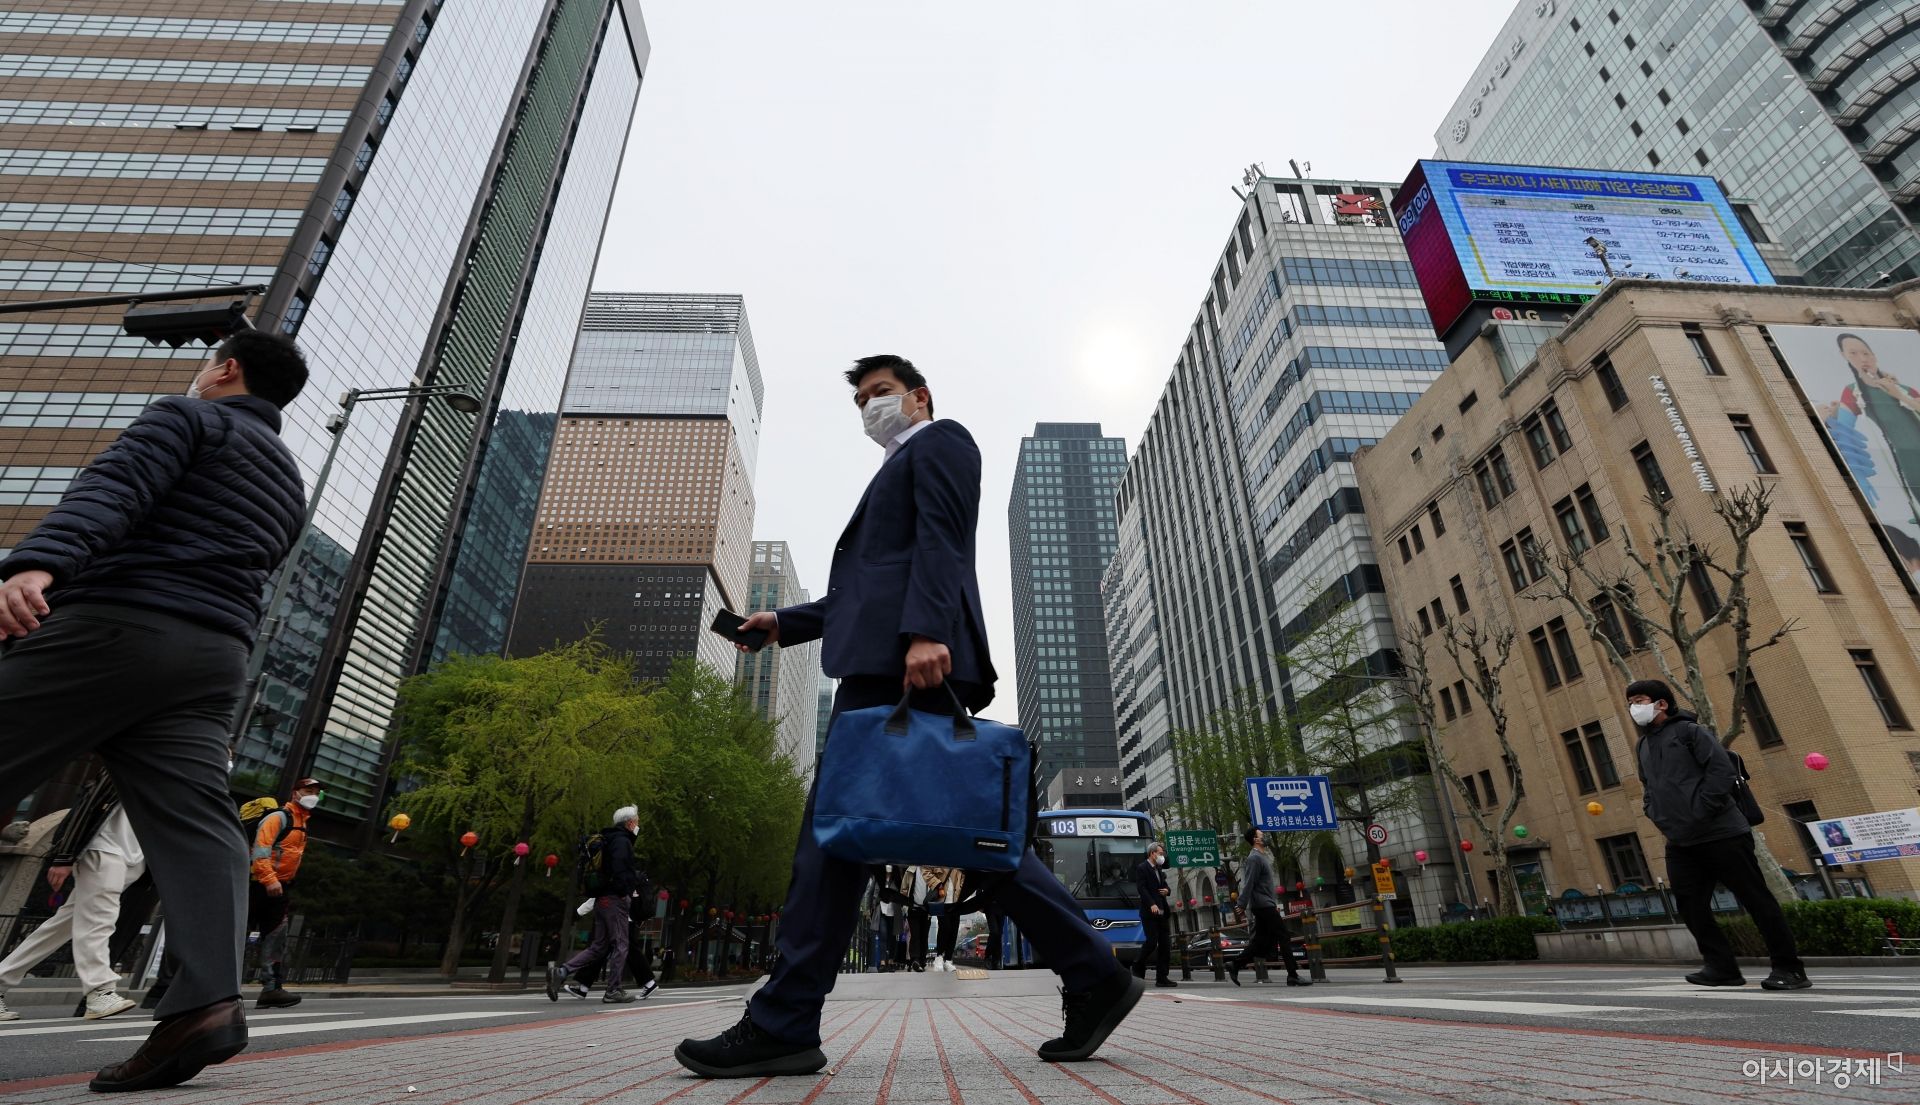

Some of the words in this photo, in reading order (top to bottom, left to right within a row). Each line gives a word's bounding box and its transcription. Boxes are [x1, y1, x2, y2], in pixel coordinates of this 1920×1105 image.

[1459, 172, 1538, 188] 우크라이나
[1540, 177, 1570, 190] 사태
[1571, 178, 1632, 194] 피해기업
[1632, 182, 1693, 197] 상담센터
[1514, 309, 1541, 321] LG
[1266, 814, 1324, 827] 중앙차로버스전용
[1051, 821, 1075, 834] 103
[1169, 835, 1194, 846] 광화문
[1371, 830, 1384, 839] 50
